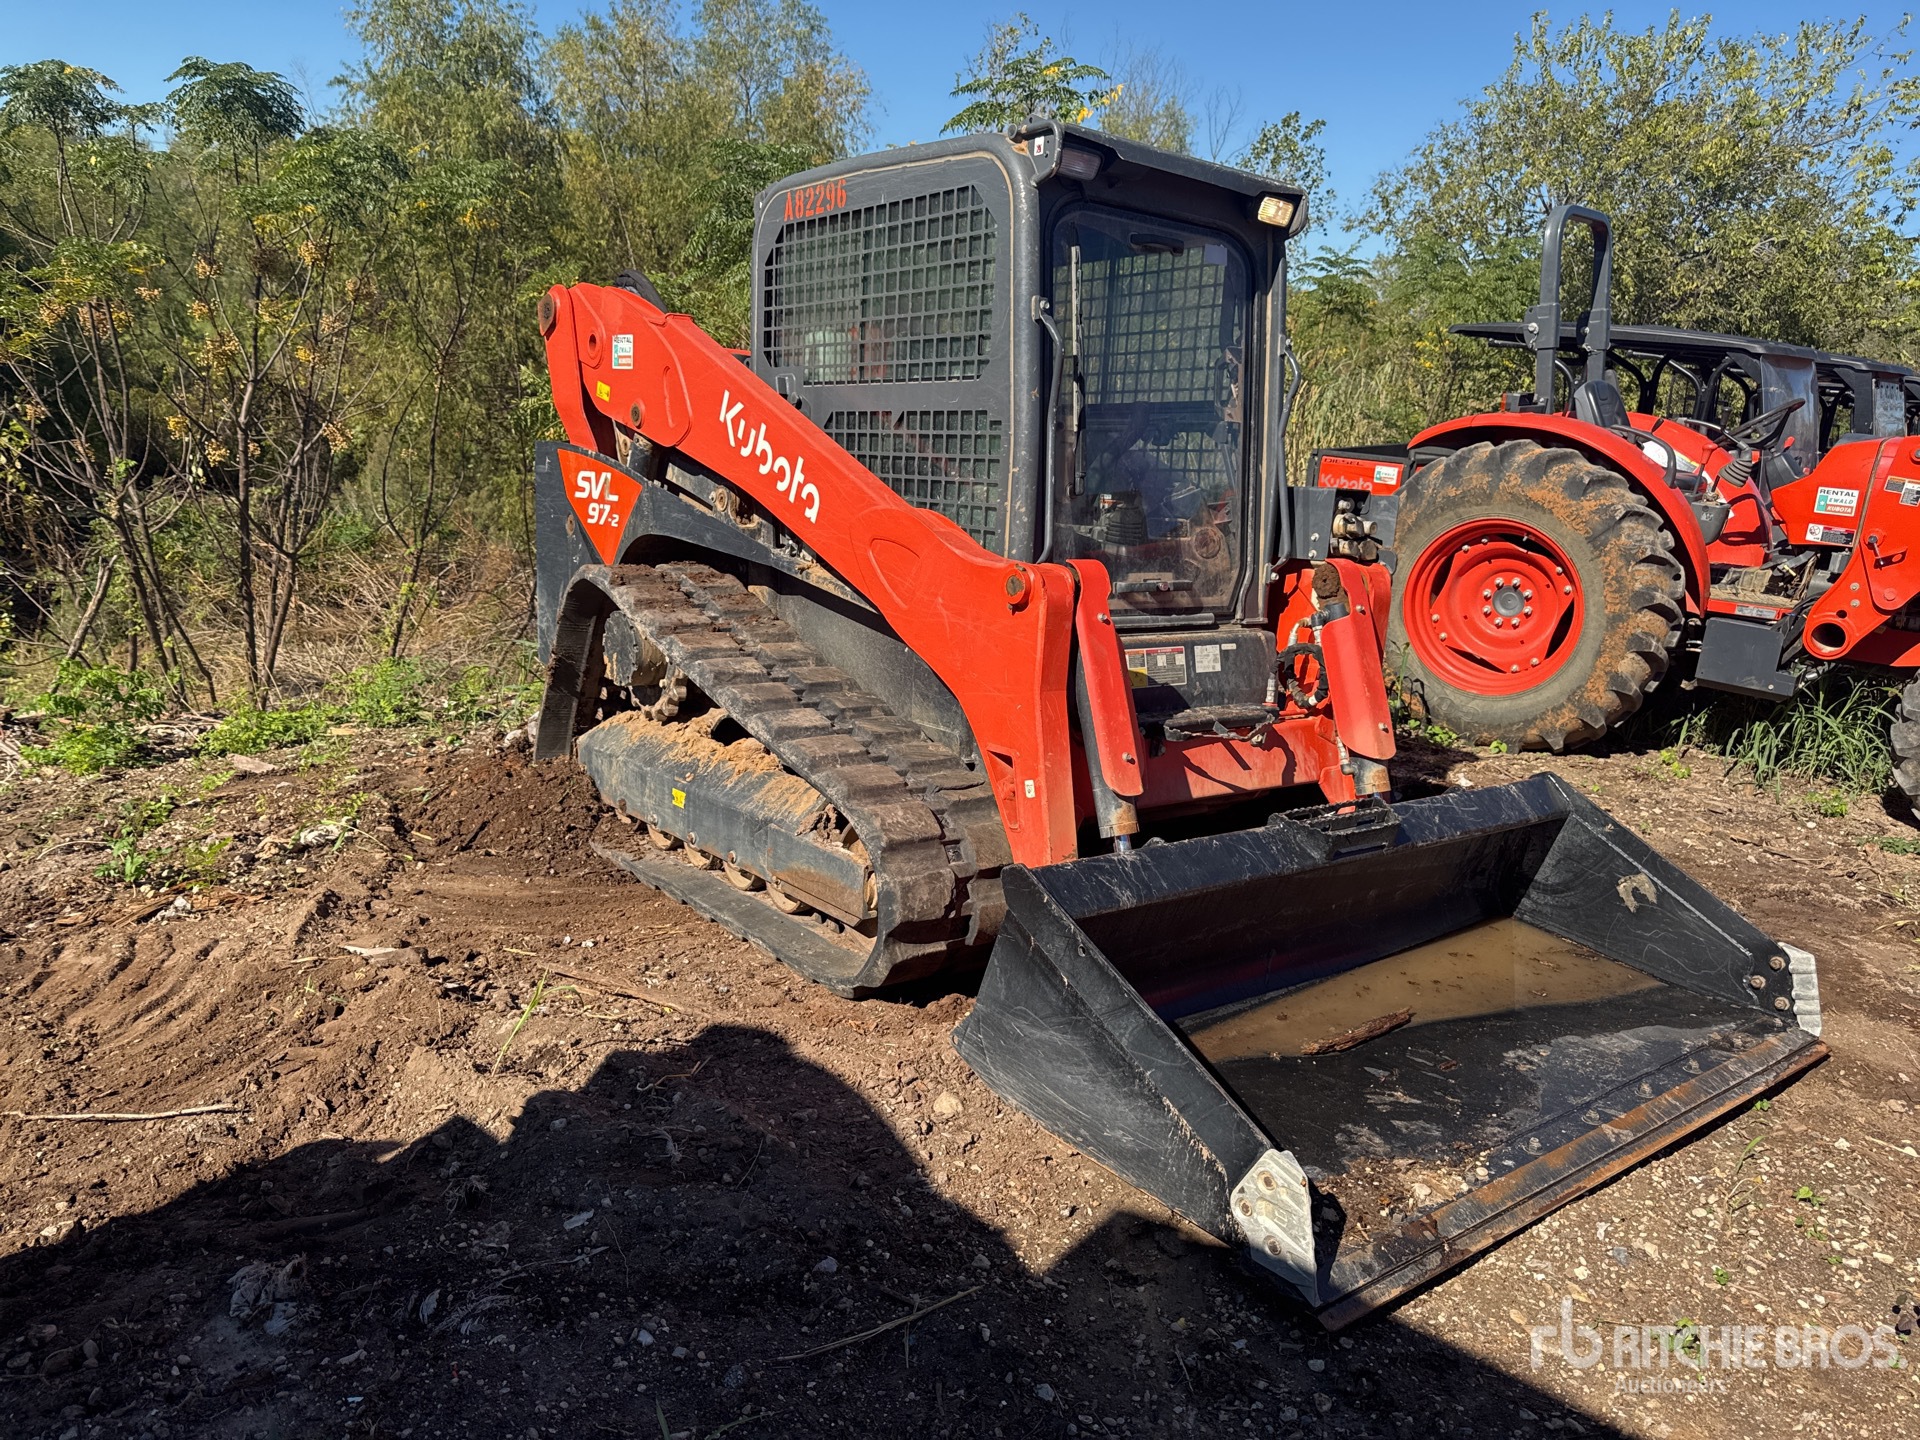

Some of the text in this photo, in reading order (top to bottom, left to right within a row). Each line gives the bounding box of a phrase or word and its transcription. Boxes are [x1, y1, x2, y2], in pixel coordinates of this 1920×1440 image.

[784, 179, 847, 222] A82296
[719, 389, 820, 524] Kubota
[574, 470, 619, 502] SVL
[1321, 473, 1373, 492] Kubota
[1819, 488, 1857, 498] RENTAL
[1826, 505, 1852, 513] KUBOTA
[1828, 497, 1854, 505] EWALD
[587, 502, 620, 527] 97-2
